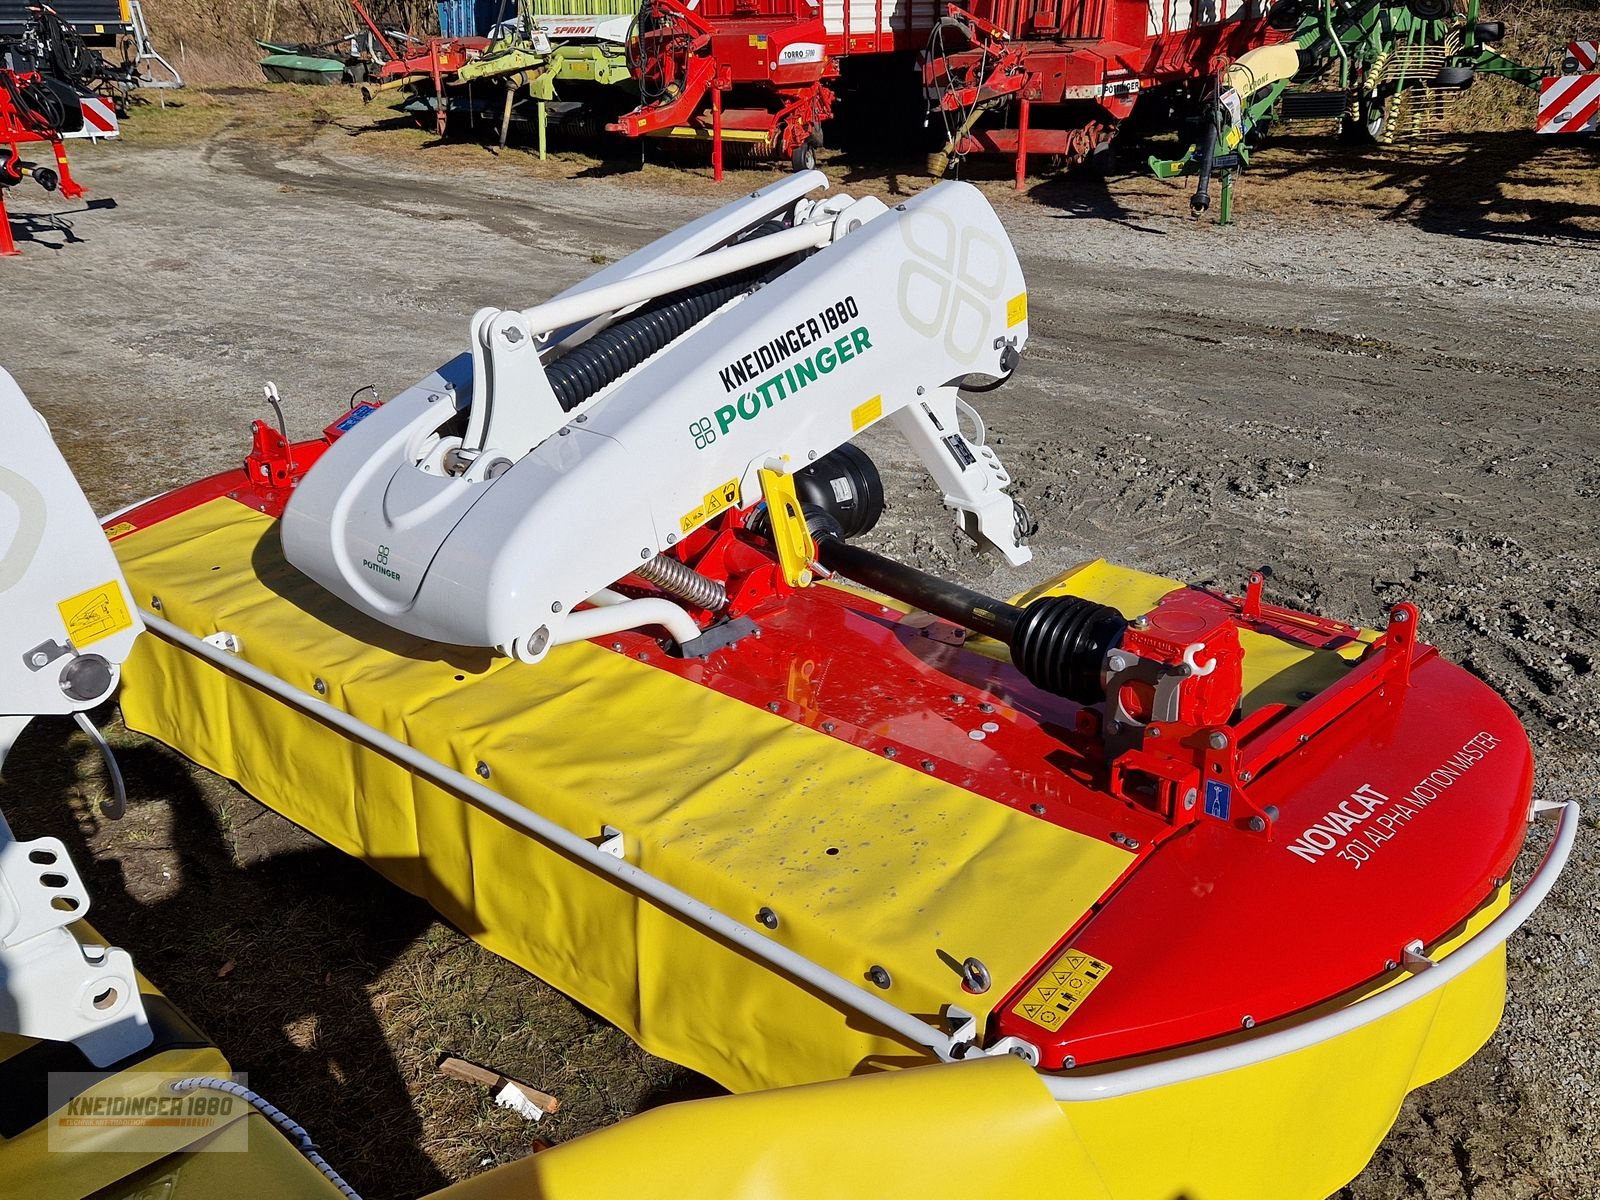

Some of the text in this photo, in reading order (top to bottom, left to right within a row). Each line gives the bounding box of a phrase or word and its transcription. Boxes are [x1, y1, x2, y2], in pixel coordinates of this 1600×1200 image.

[553, 26, 595, 34] SPRINT
[784, 51, 803, 59] TORRO
[718, 295, 859, 393] KNEIDINGER 1880
[1286, 783, 1389, 864] NOVACAT
[1336, 731, 1502, 870] 301 ALPHA MOTION MASTER
